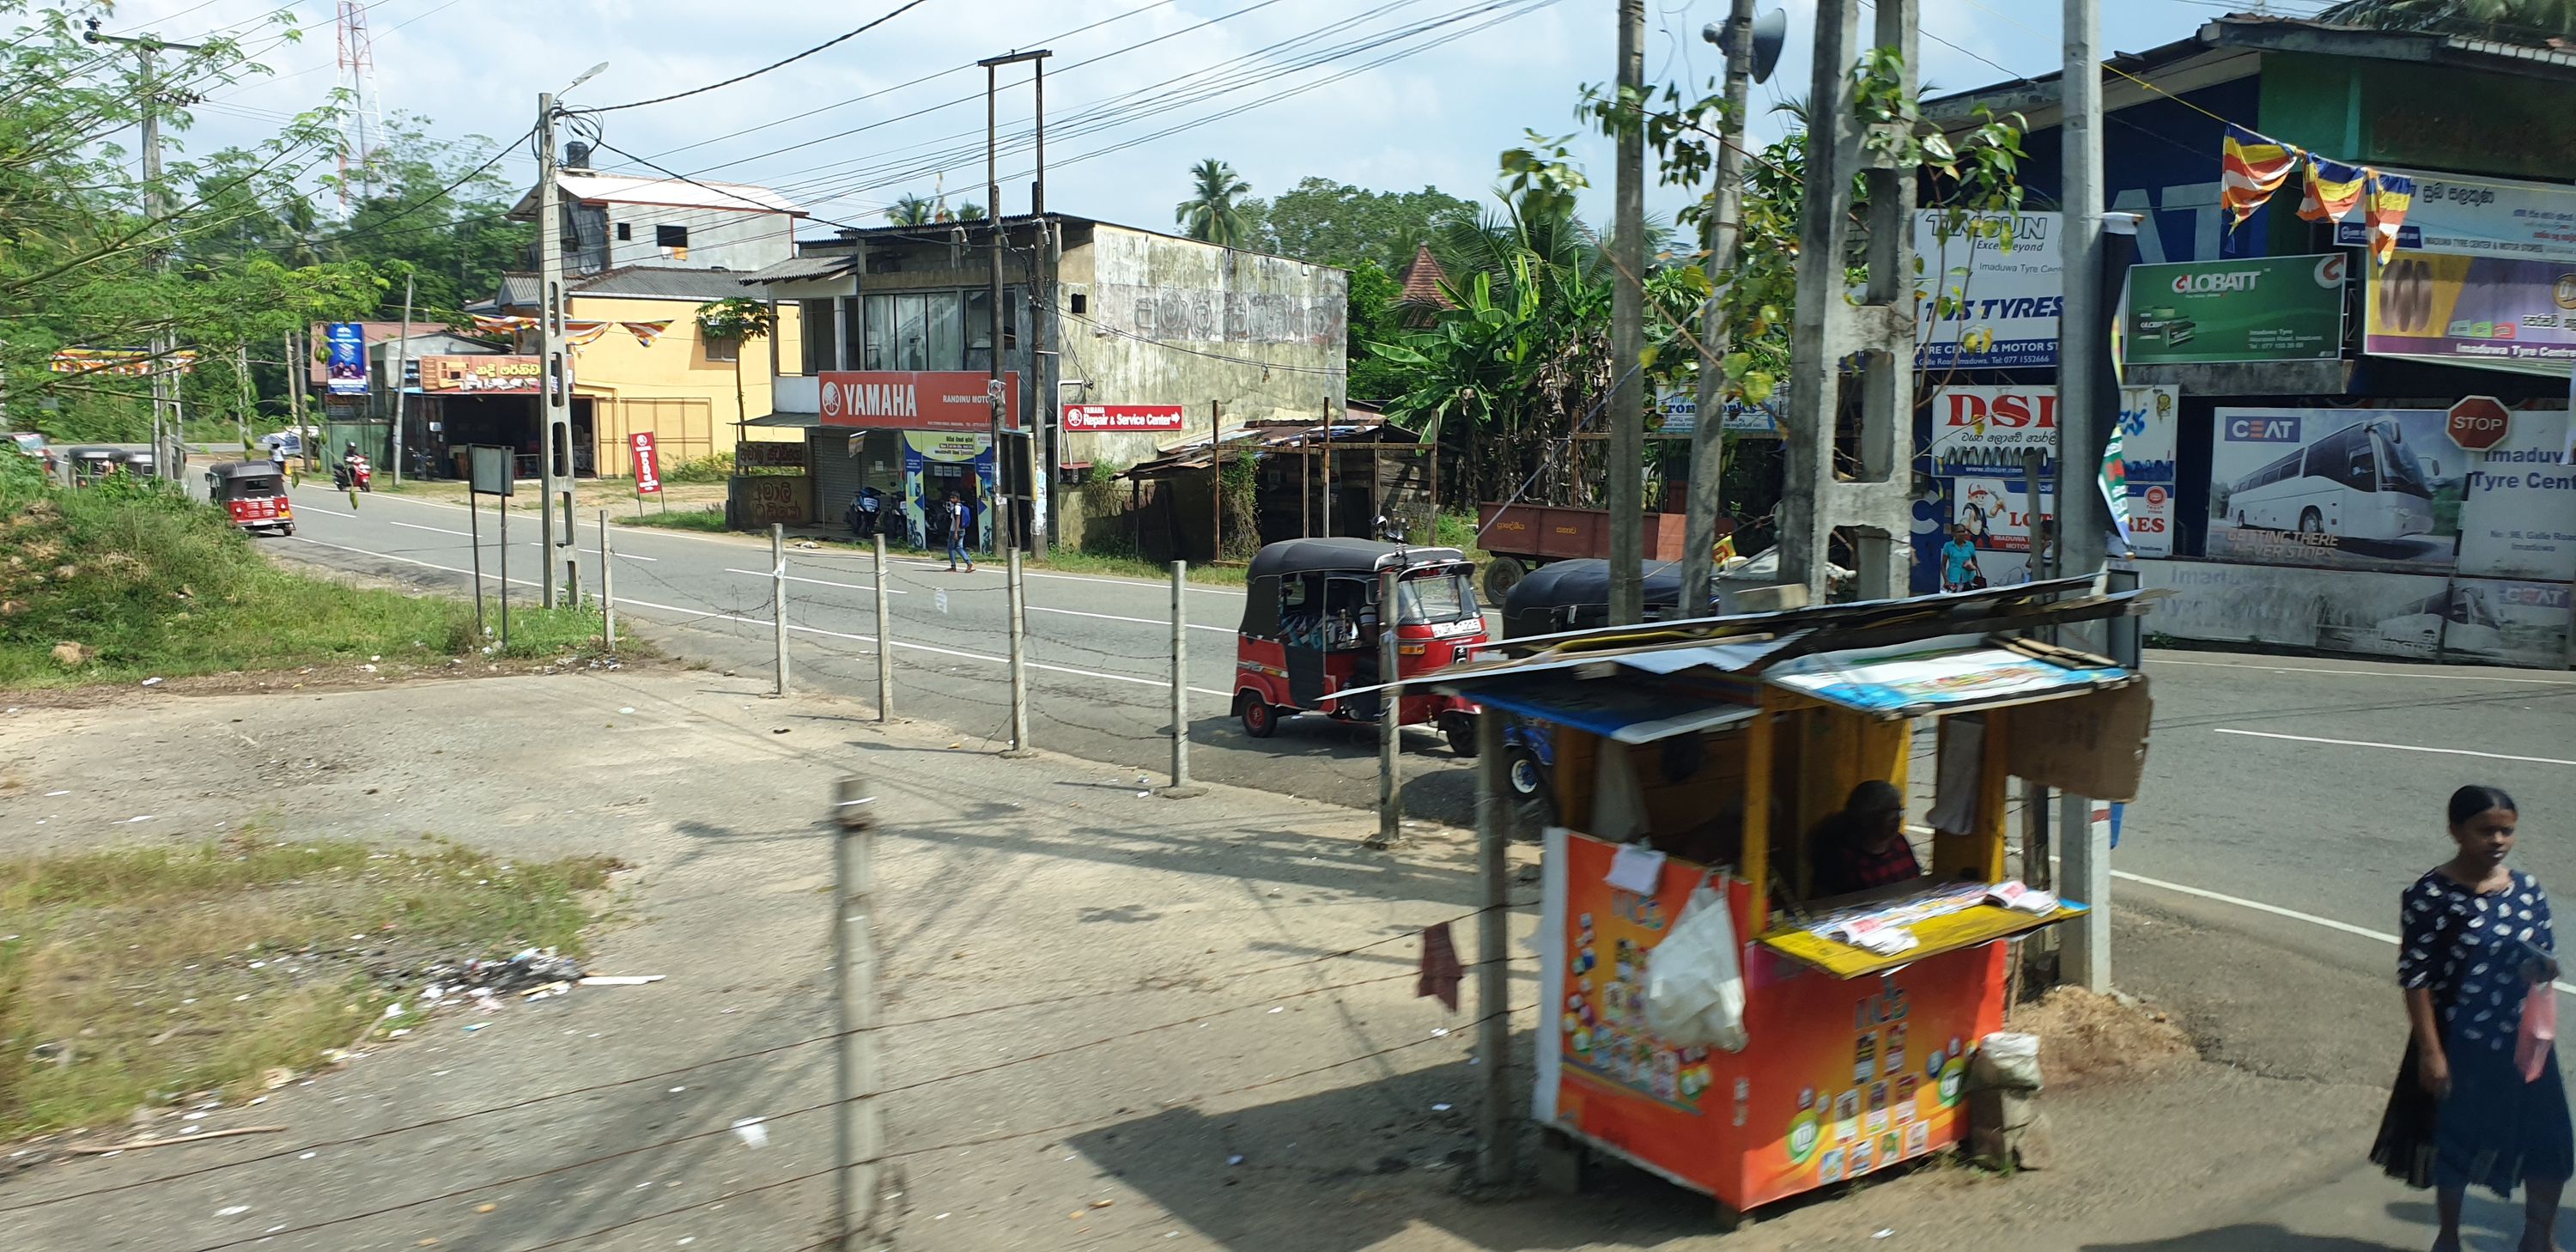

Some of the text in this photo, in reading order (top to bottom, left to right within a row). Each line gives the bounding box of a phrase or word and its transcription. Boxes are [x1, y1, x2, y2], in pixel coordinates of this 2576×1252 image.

[1979, 262, 2018, 272] Imaduwa
[2020, 264, 2038, 274] Tyre
[2172, 270, 2261, 294] GLOBATT
[1980, 295, 2063, 319] TYRES
[1991, 343, 1999, 353] &
[2001, 343, 2044, 353] MOTOR
[2456, 343, 2508, 356] Imaduwa
[2512, 345, 2537, 358] Tyre
[844, 384, 918, 417] YAMAHA
[943, 394, 971, 404] RANDINU
[1946, 394, 2057, 428] DSI
[1083, 414, 1109, 428] Repair
[1116, 414, 1145, 426] Service
[1146, 414, 1171, 425] Center
[2454, 416, 2503, 431] STOP
[2233, 420, 2294, 439] CEAT
[2472, 471, 2520, 491] Tyre
[2291, 532, 2339, 546] THERE
[2287, 545, 2336, 559] STOPS
